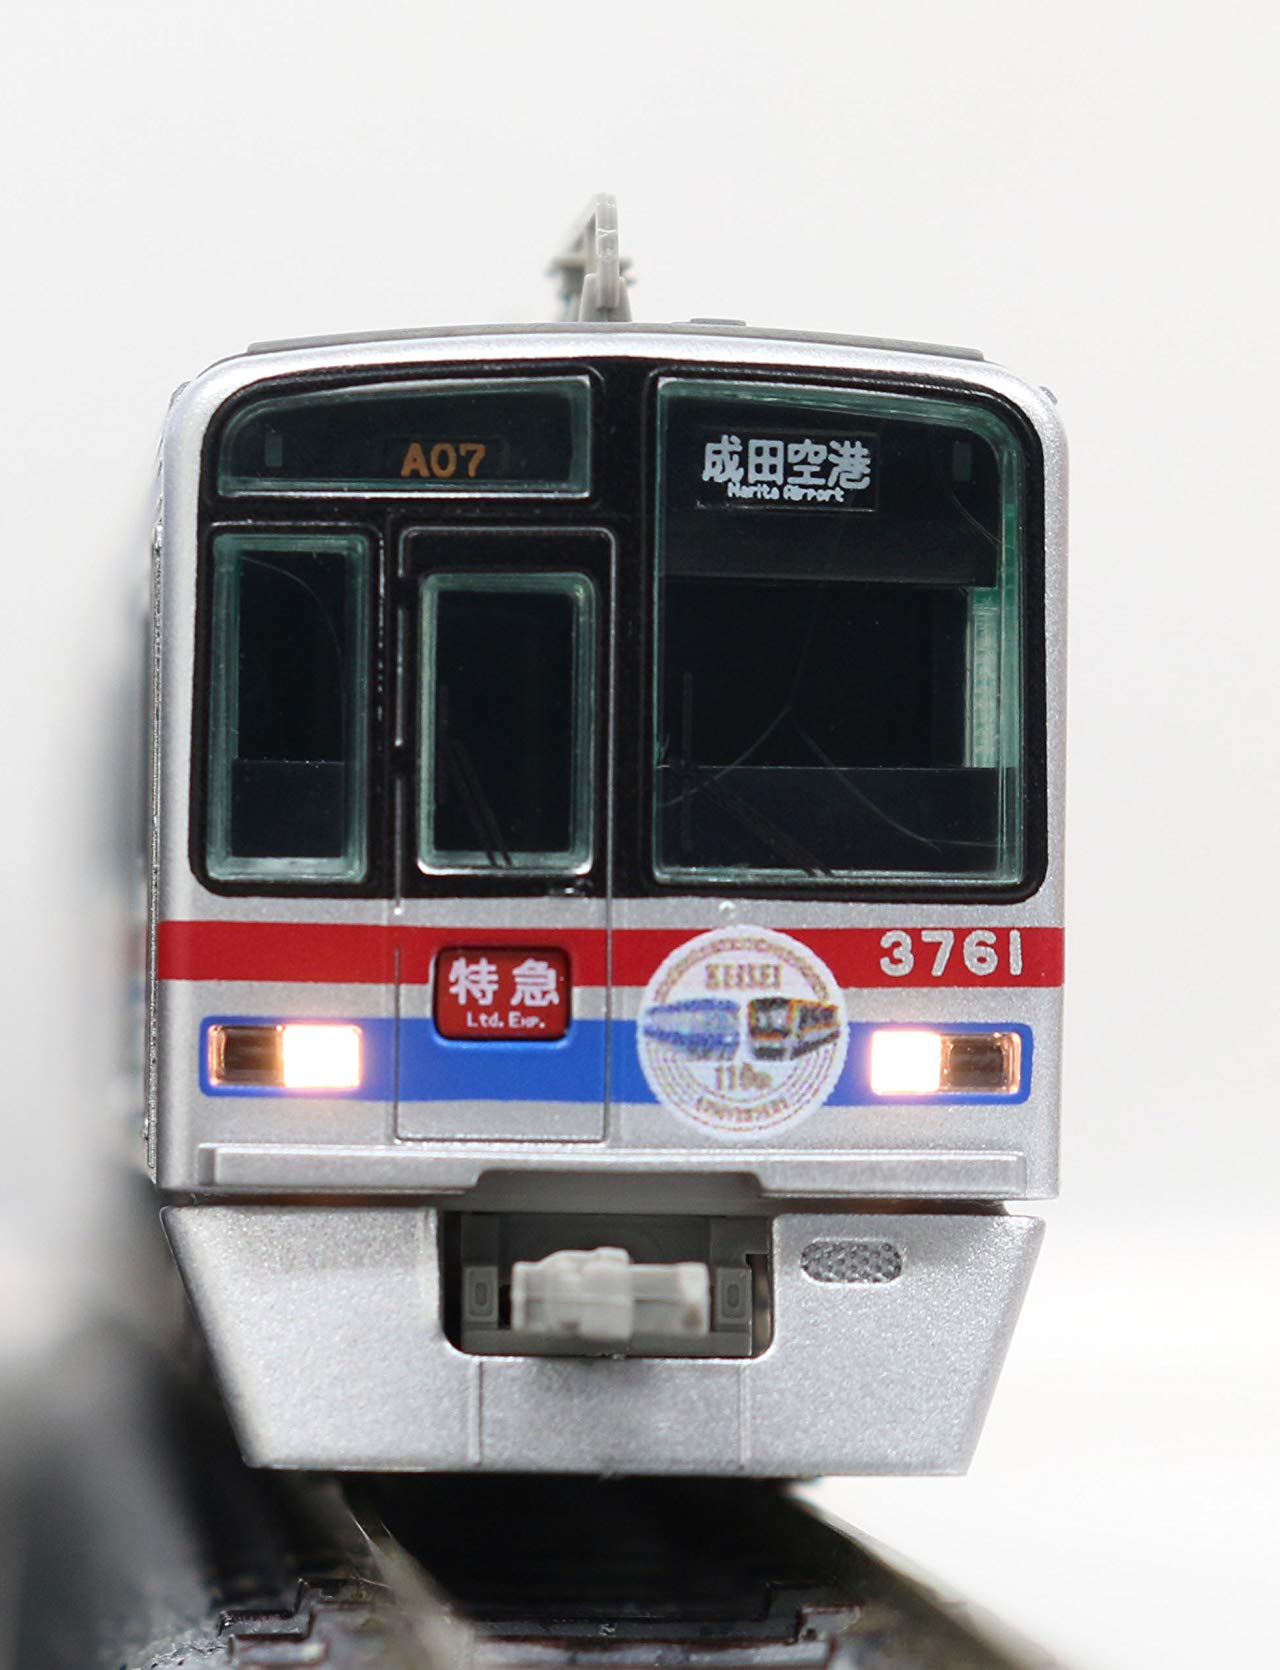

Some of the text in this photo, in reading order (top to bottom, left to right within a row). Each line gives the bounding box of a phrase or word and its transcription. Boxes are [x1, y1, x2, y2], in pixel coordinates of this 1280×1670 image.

[401, 441, 486, 478] A07
[702, 434, 870, 489] 成田空港
[880, 929, 1023, 977] 3761
[448, 956, 560, 1007] 特急
[704, 963, 782, 990] KEISEI
[466, 1011, 504, 1028] Ltd.
